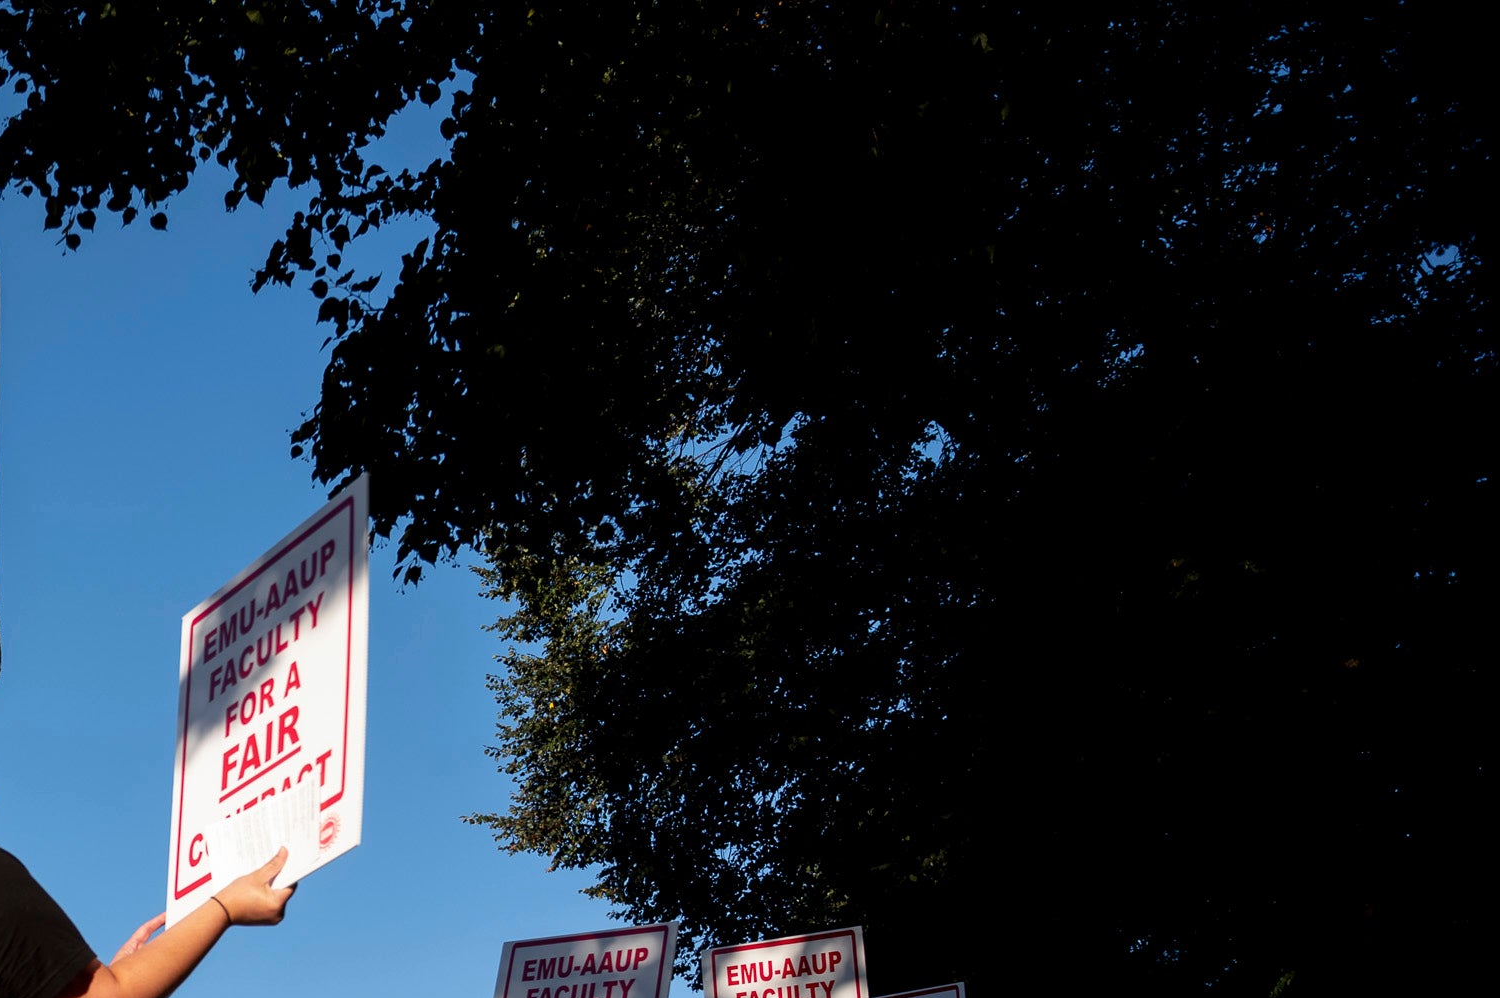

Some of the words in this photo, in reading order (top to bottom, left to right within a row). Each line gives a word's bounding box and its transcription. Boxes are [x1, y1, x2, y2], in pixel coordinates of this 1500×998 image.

[202, 538, 337, 665] EMU-AAUP
[208, 591, 325, 703] FACULTY
[225, 678, 274, 739] FOR
[283, 660, 302, 700] A
[220, 705, 301, 792] FAIR
[521, 947, 649, 983] EMU-AAUP
[726, 950, 842, 987] EMU-AAUP
